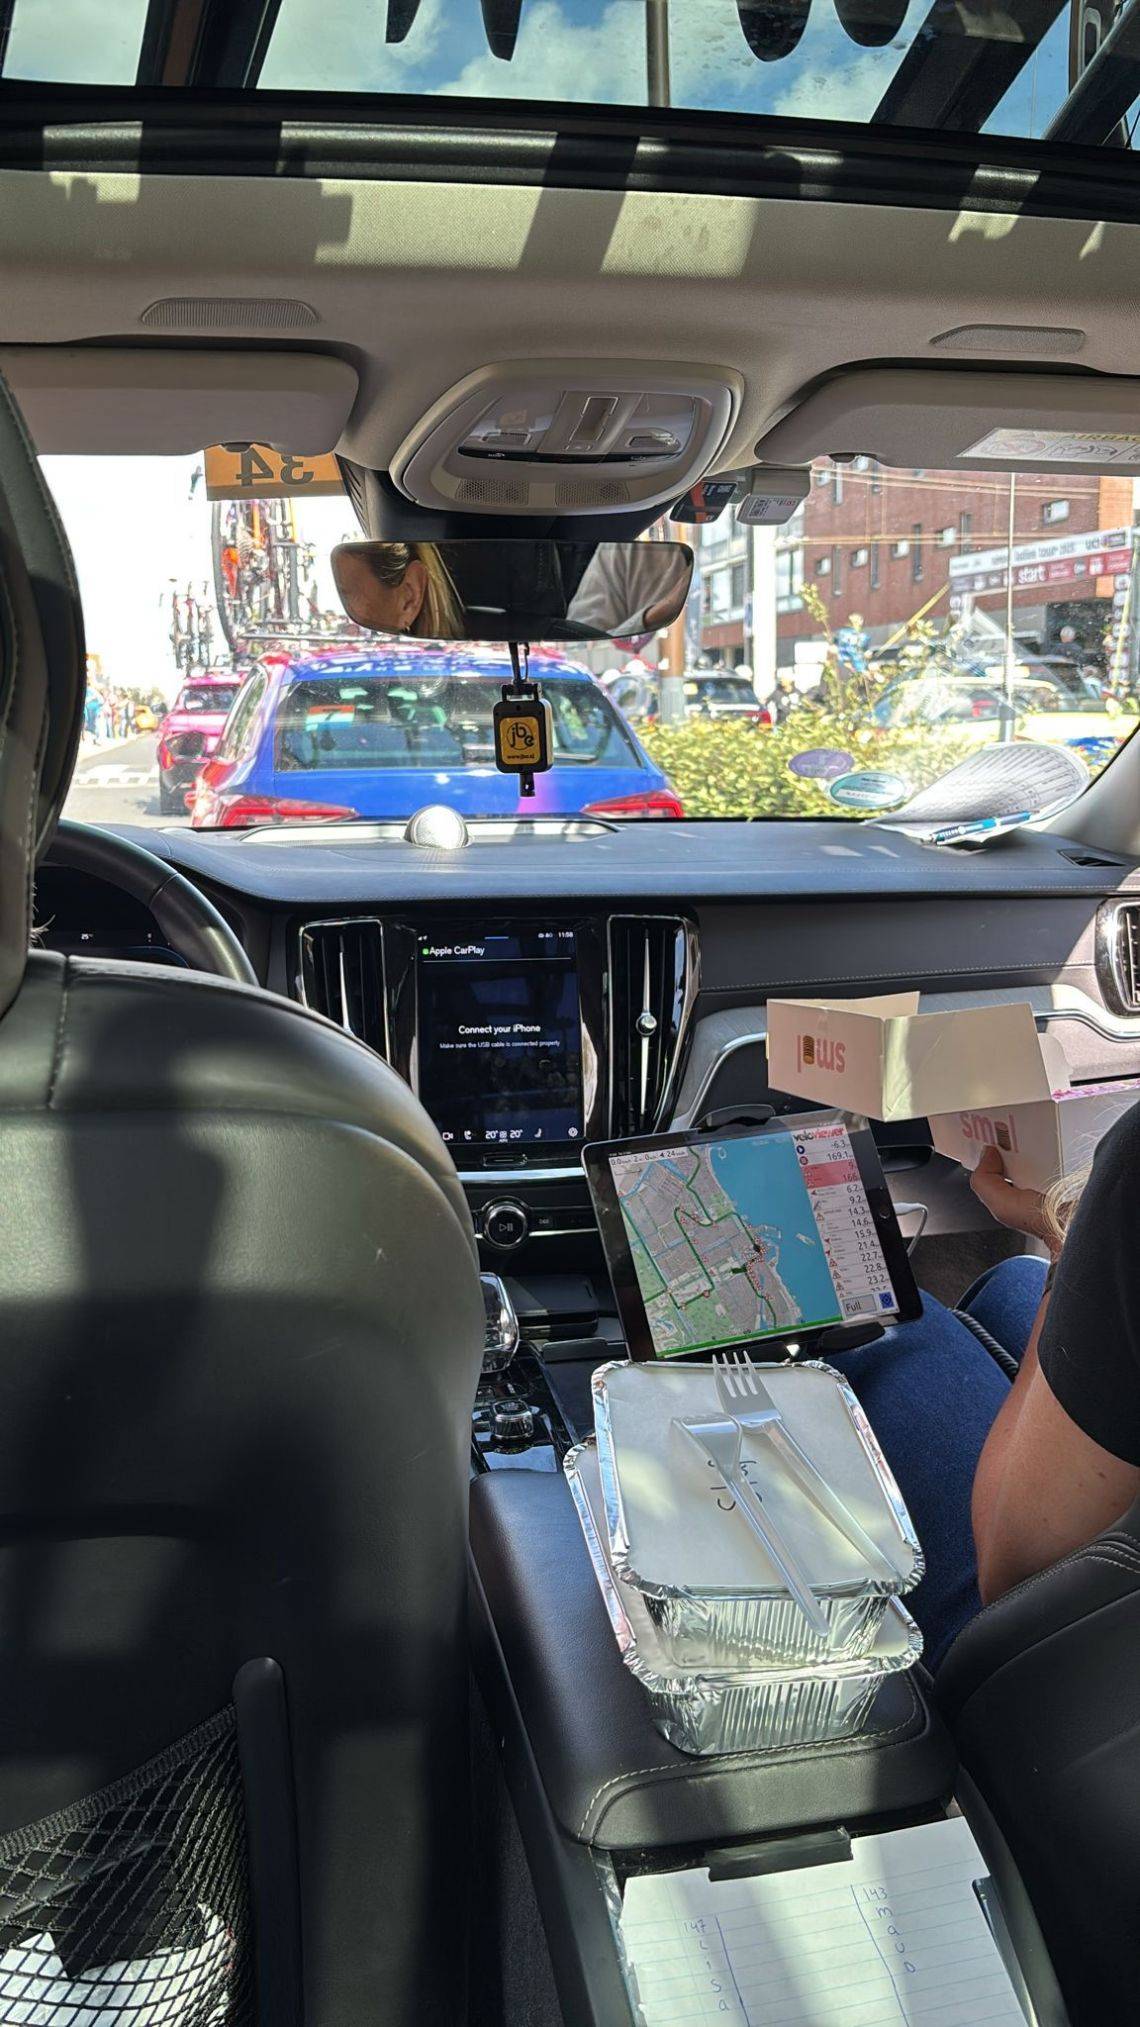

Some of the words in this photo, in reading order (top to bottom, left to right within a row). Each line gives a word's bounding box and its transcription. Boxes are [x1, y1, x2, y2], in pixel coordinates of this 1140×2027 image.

[1018, 564, 1047, 585] start
[429, 947, 452, 956] Apple
[454, 945, 485, 956] CarPlay
[458, 1024, 492, 1034] Connect
[494, 1025, 511, 1035] your
[513, 1023, 541, 1033] iPhone
[539, 1040, 560, 1048] properly
[826, 1151, 848, 1160] 169.1
[847, 1184, 858, 1193] 6.2
[849, 1195, 861, 1204] 9.2
[848, 1207, 865, 1216] 14.3
[851, 1217, 870, 1227] 14.6
[854, 1229, 872, 1239] 15.9
[858, 1240, 876, 1250] 21.4
[861, 1251, 878, 1262] 22.7
[864, 1263, 882, 1273] 22.8
[867, 1274, 885, 1285] 23.2
[845, 1302, 862, 1312] Full
[863, 1887, 888, 1902] 143
[684, 1919, 706, 1934] 147
